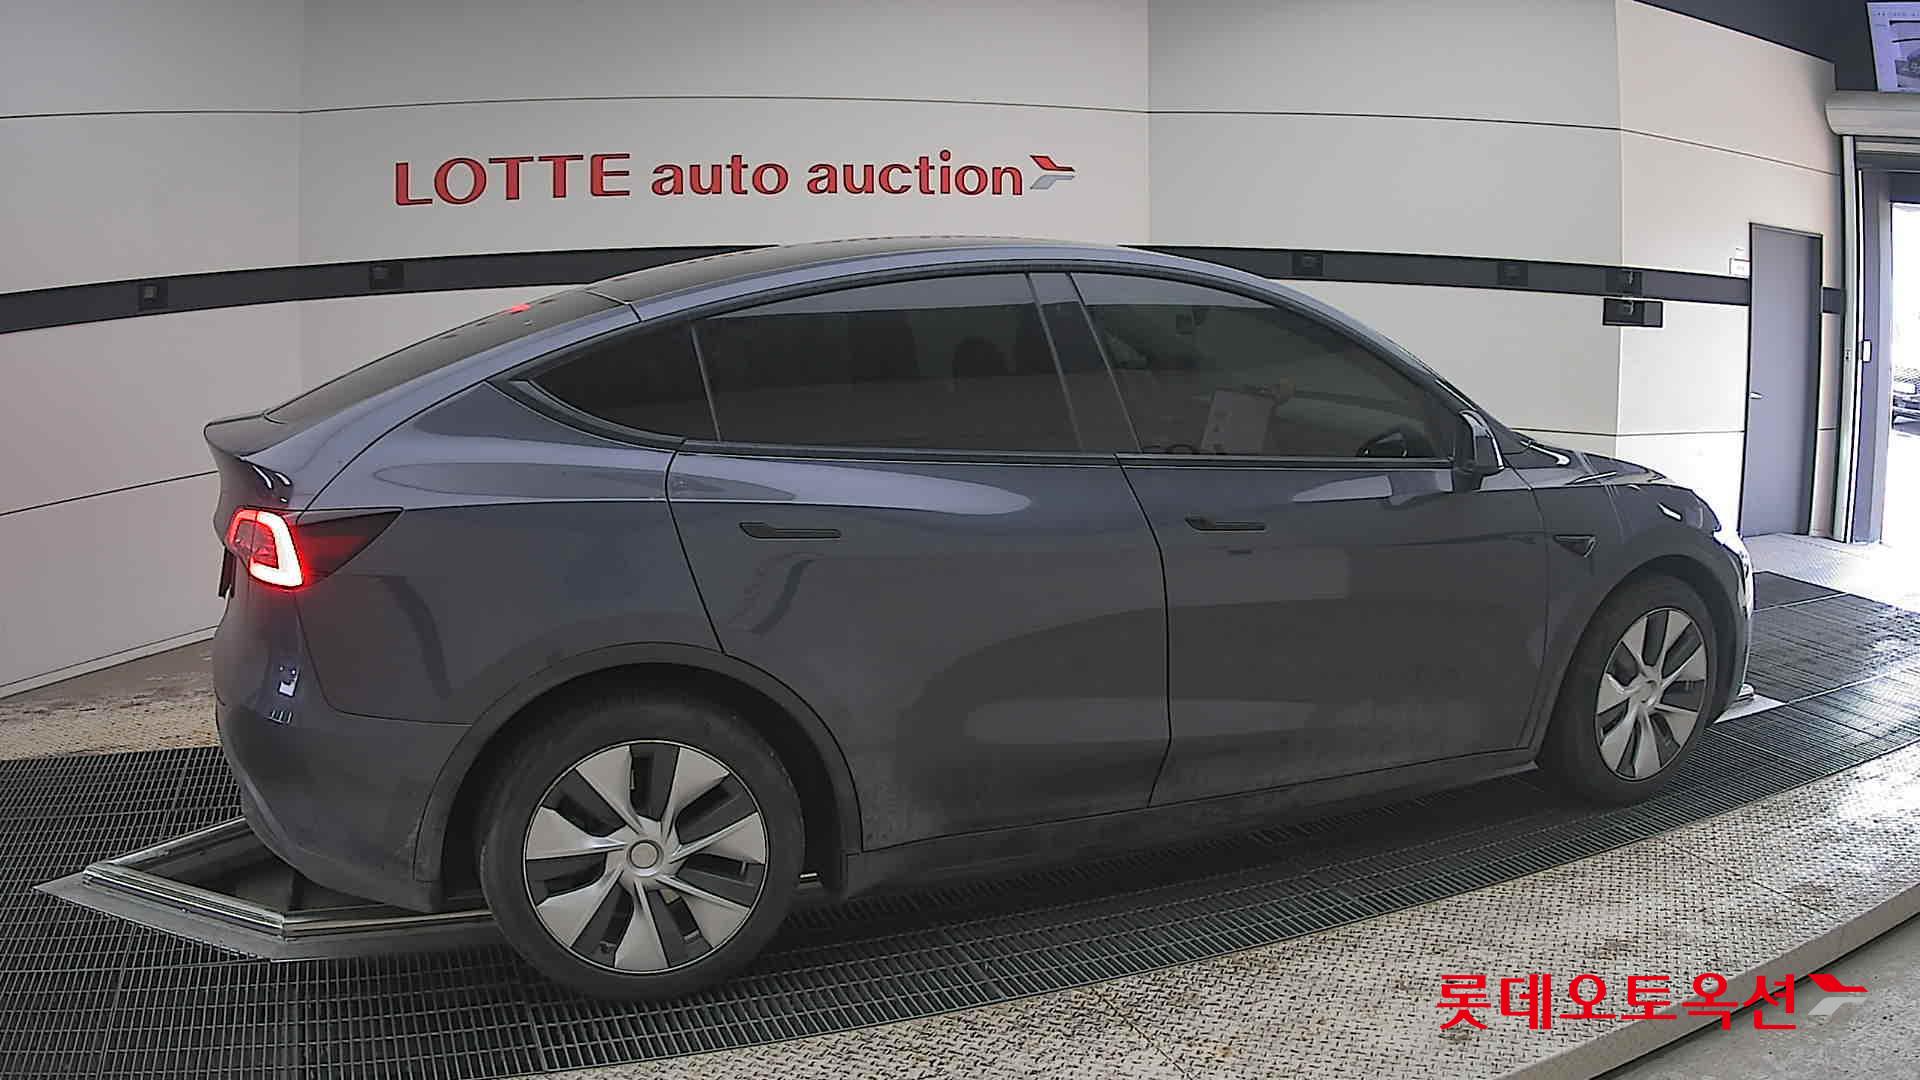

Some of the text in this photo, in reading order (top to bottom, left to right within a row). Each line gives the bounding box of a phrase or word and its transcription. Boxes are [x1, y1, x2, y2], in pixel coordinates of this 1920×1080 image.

[394, 150, 1024, 206] LOTTE auto auction
